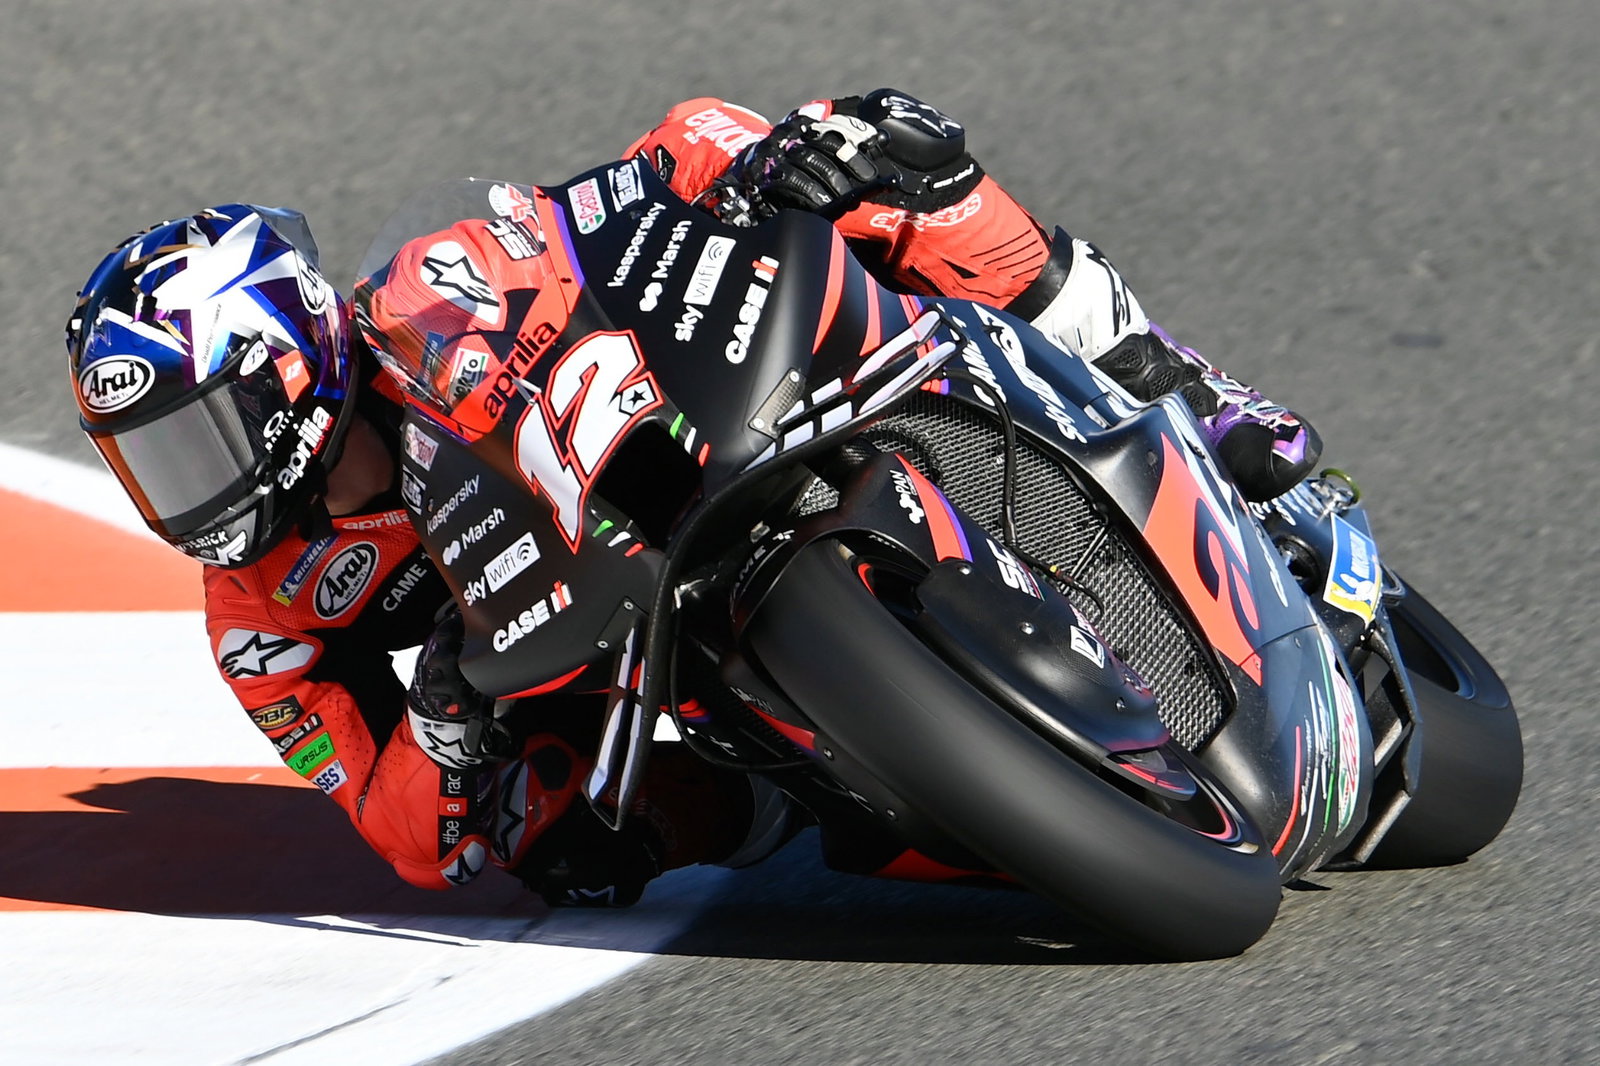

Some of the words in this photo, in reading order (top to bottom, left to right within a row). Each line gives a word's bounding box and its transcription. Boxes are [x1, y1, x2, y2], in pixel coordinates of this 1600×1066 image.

[607, 202, 667, 288] kaspersky
[651, 220, 692, 279] Marsh
[675, 305, 704, 342] sky
[693, 264, 717, 299] wifi
[725, 280, 772, 364] CASE
[84, 362, 137, 403] Arai
[483, 321, 560, 420] aprilia
[277, 406, 331, 490] aprilia
[426, 474, 480, 536] kaspersky
[461, 507, 506, 550] Marsh
[324, 547, 369, 615] Arai
[382, 563, 428, 612] CAME
[463, 576, 488, 607] sky
[490, 552, 517, 584] wifi
[493, 599, 551, 652] CASE
[272, 727, 305, 753] ASE
[295, 740, 329, 770] URSUS
[315, 767, 341, 791] SES
[447, 773, 462, 794] rac
[442, 820, 460, 845] #be
[446, 803, 460, 813] a
